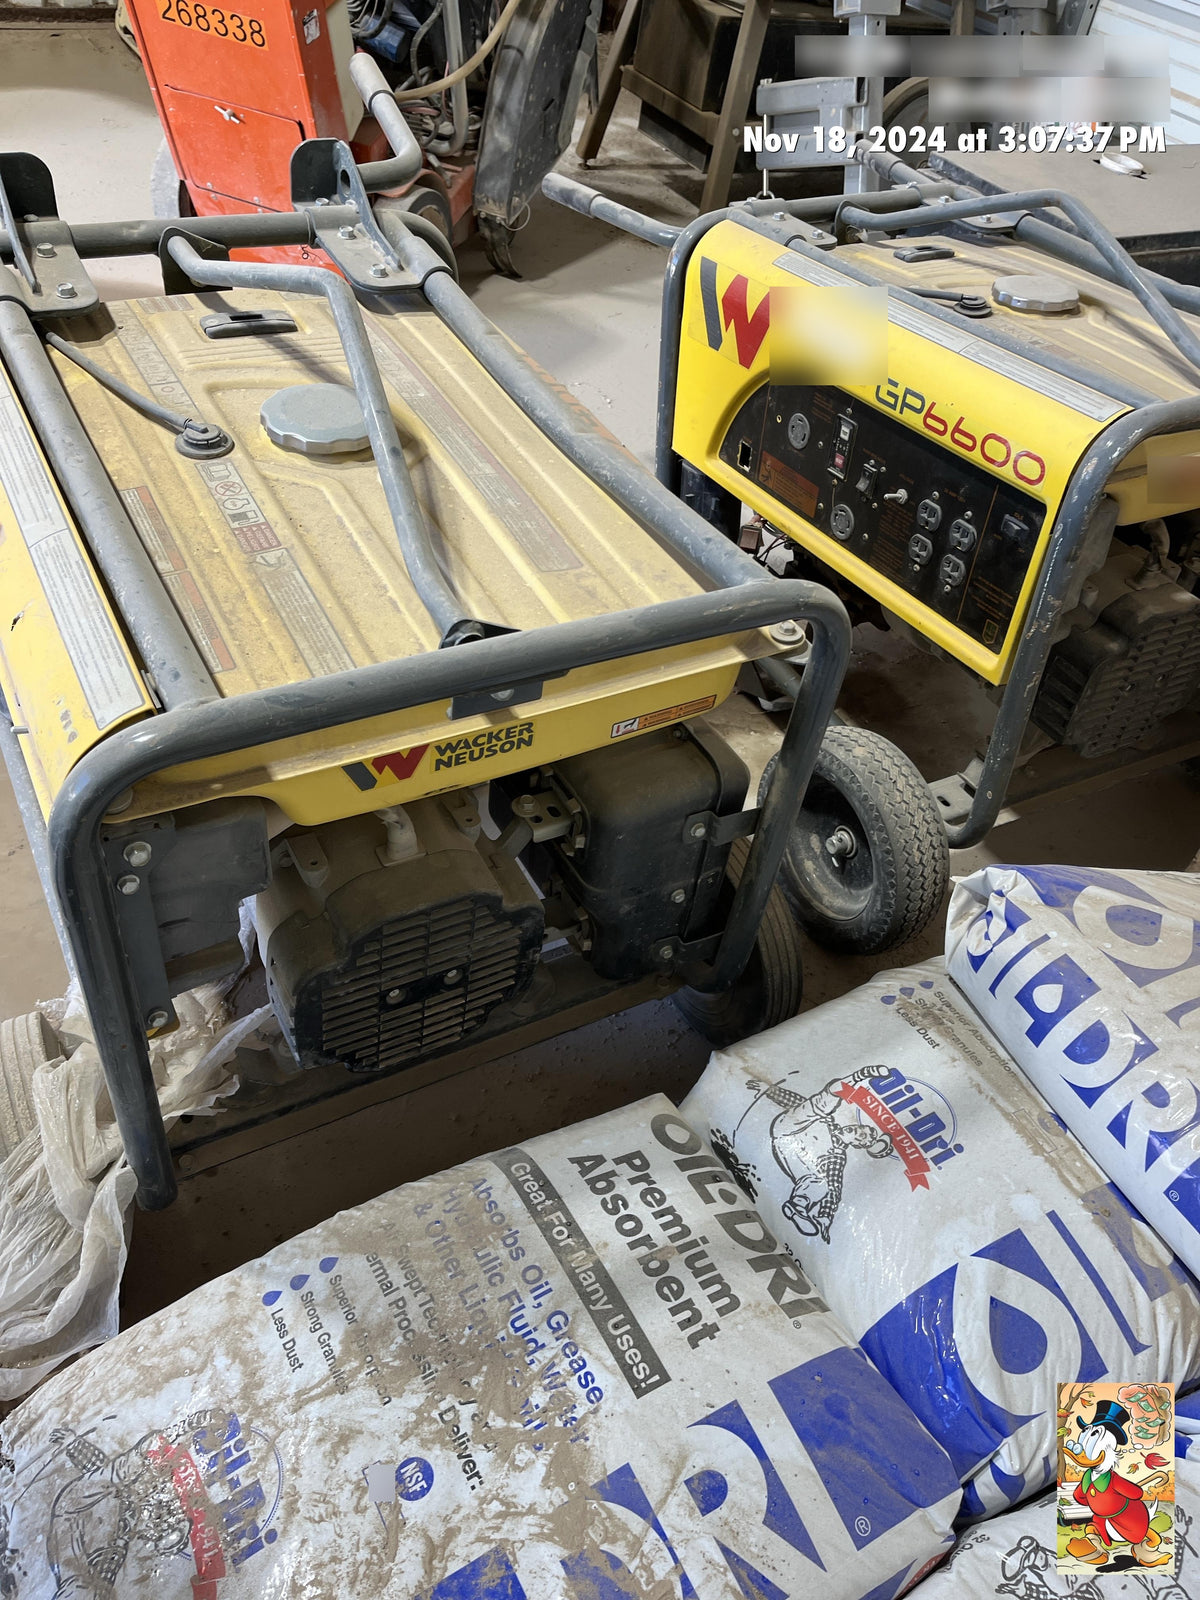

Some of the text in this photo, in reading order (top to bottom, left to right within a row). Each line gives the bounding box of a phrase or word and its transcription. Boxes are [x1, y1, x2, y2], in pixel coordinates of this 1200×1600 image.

[162, 0, 266, 48] 268338
[875, 378, 1046, 486] GP6600
[434, 722, 535, 757] WACKER
[434, 734, 534, 771] NEUSON
[915, 1025, 941, 1050] Dust
[861, 1094, 920, 1160] SINCE 1941
[567, 1155, 722, 1350] Absorbent
[612, 1149, 742, 1318] Premium
[328, 1272, 360, 1326] Superior
[509, 1160, 660, 1388] Great For Many Uses!
[518, 1261, 557, 1310] Oil,
[299, 1289, 325, 1333] Strong
[269, 1307, 303, 1373] Less Dust
[399, 1461, 427, 1492] NSF
